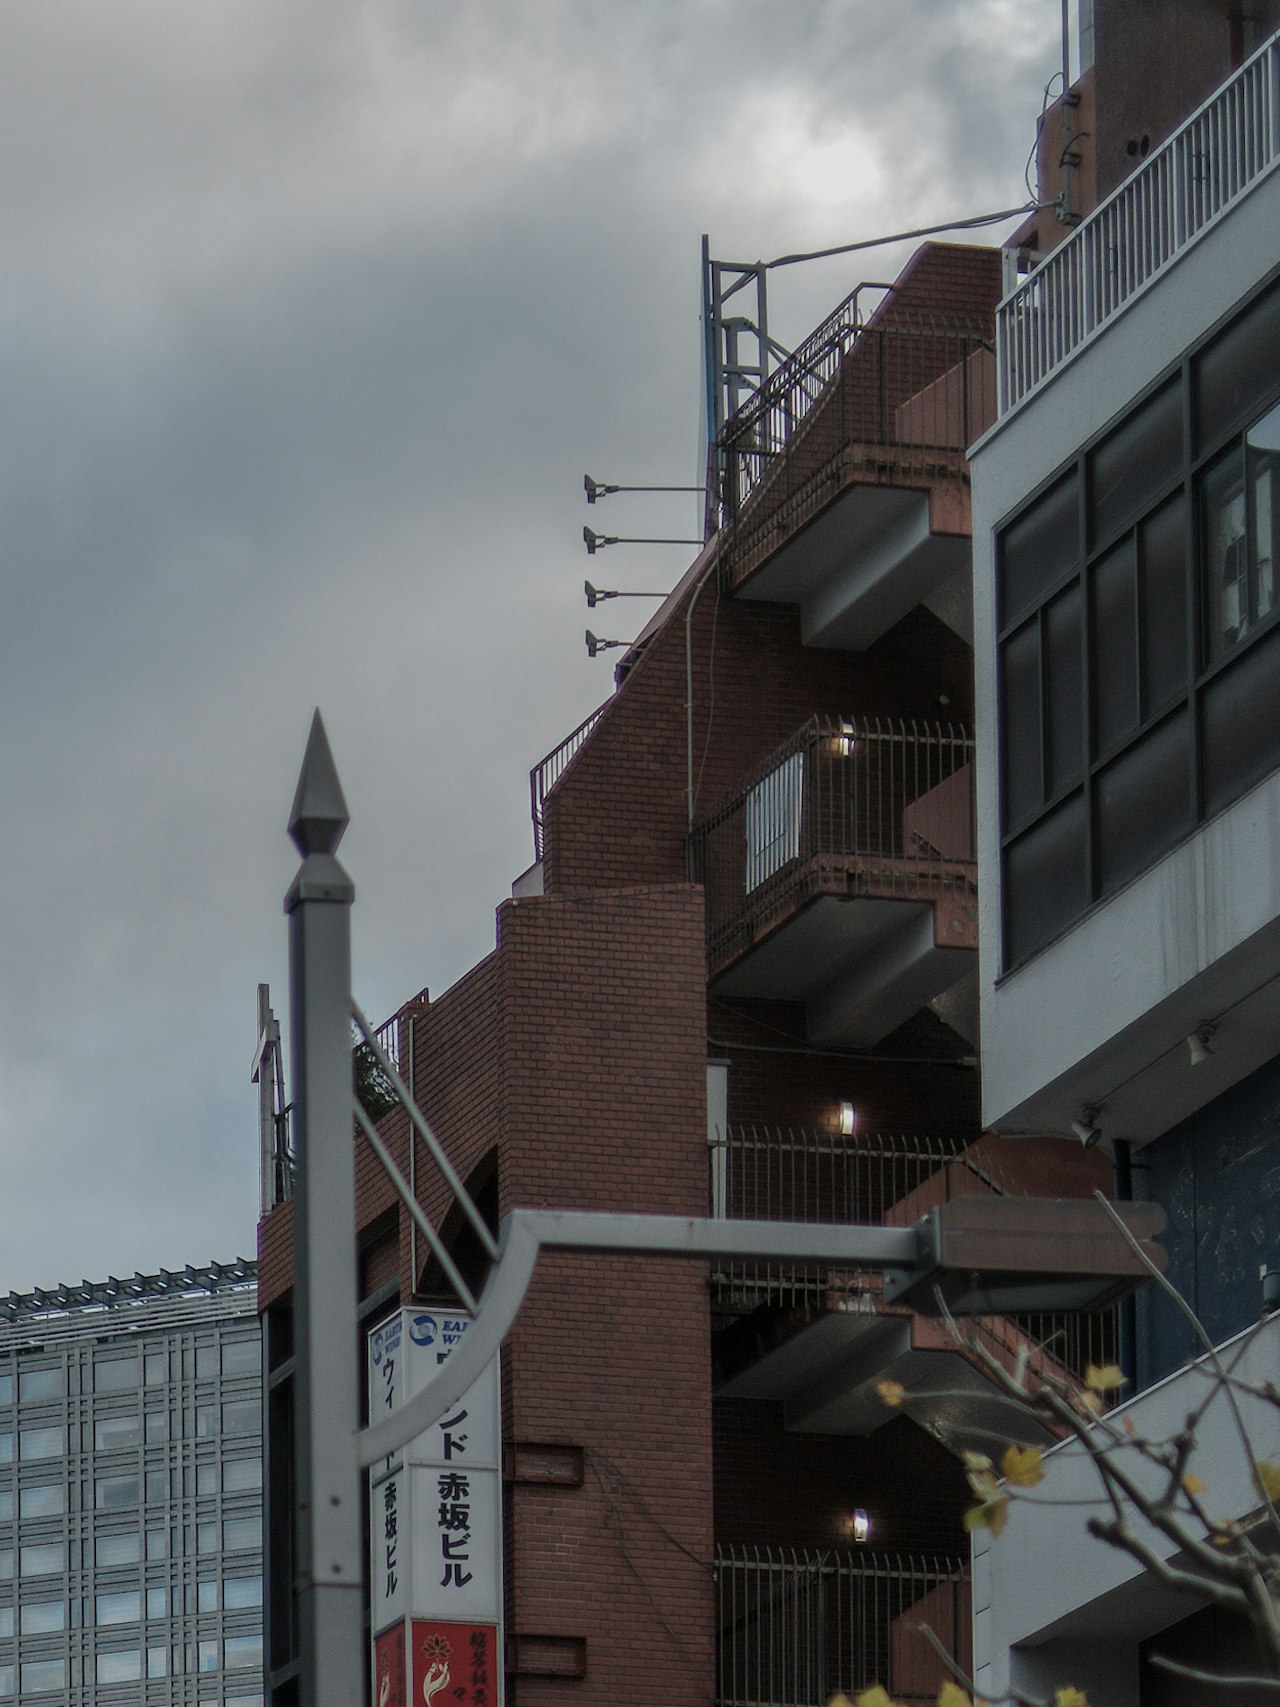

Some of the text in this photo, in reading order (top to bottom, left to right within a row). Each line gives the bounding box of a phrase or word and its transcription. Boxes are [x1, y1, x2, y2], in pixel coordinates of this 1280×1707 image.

[383, 1482, 399, 1598] 赤坂ビル
[436, 1472, 473, 1588] 赤坂ビル
